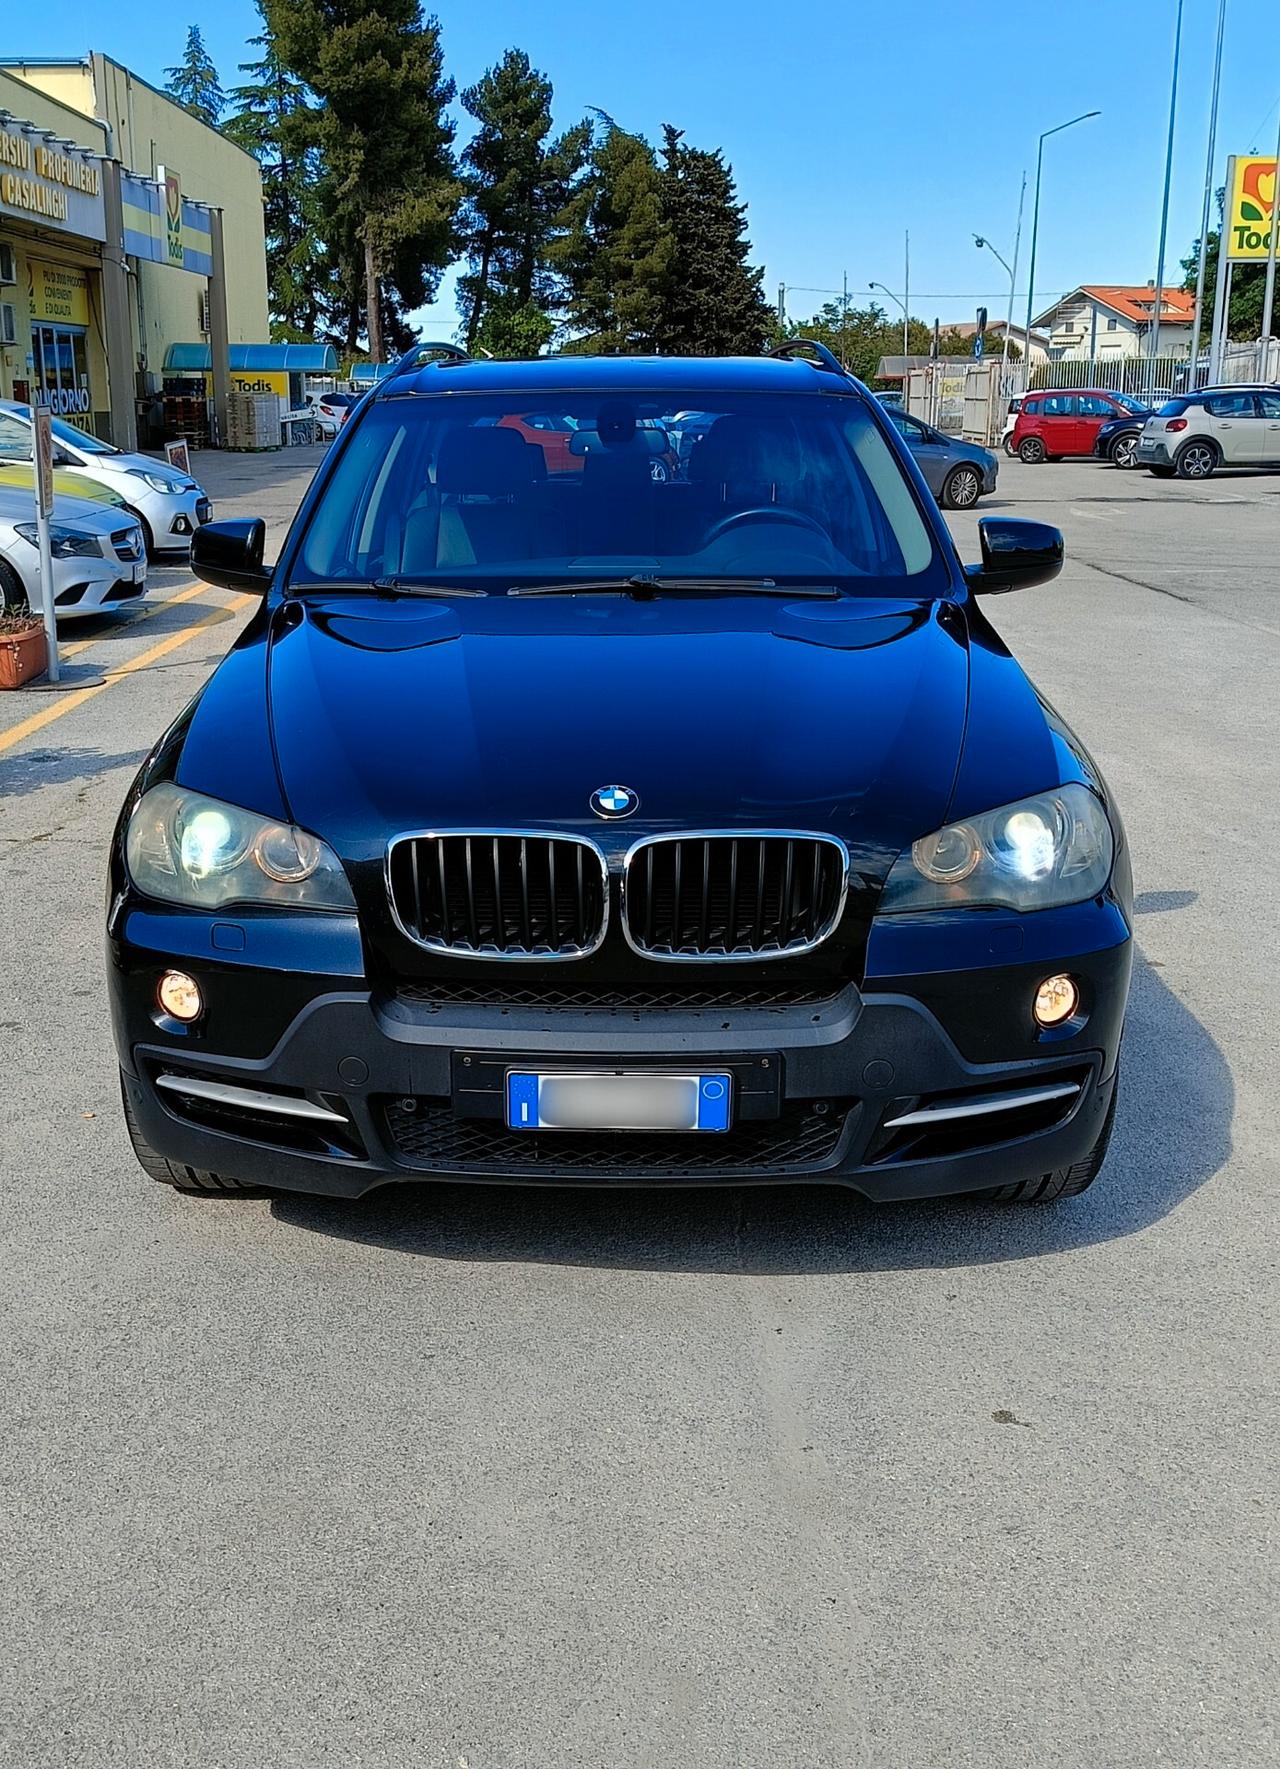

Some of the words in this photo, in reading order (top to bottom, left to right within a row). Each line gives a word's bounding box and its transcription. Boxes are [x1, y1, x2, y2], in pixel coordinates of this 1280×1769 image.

[41, 146, 100, 197] PROFUMERIA
[7, 173, 68, 221] CASALINGHI
[168, 233, 183, 260] Todis
[234, 378, 272, 392] Todis
